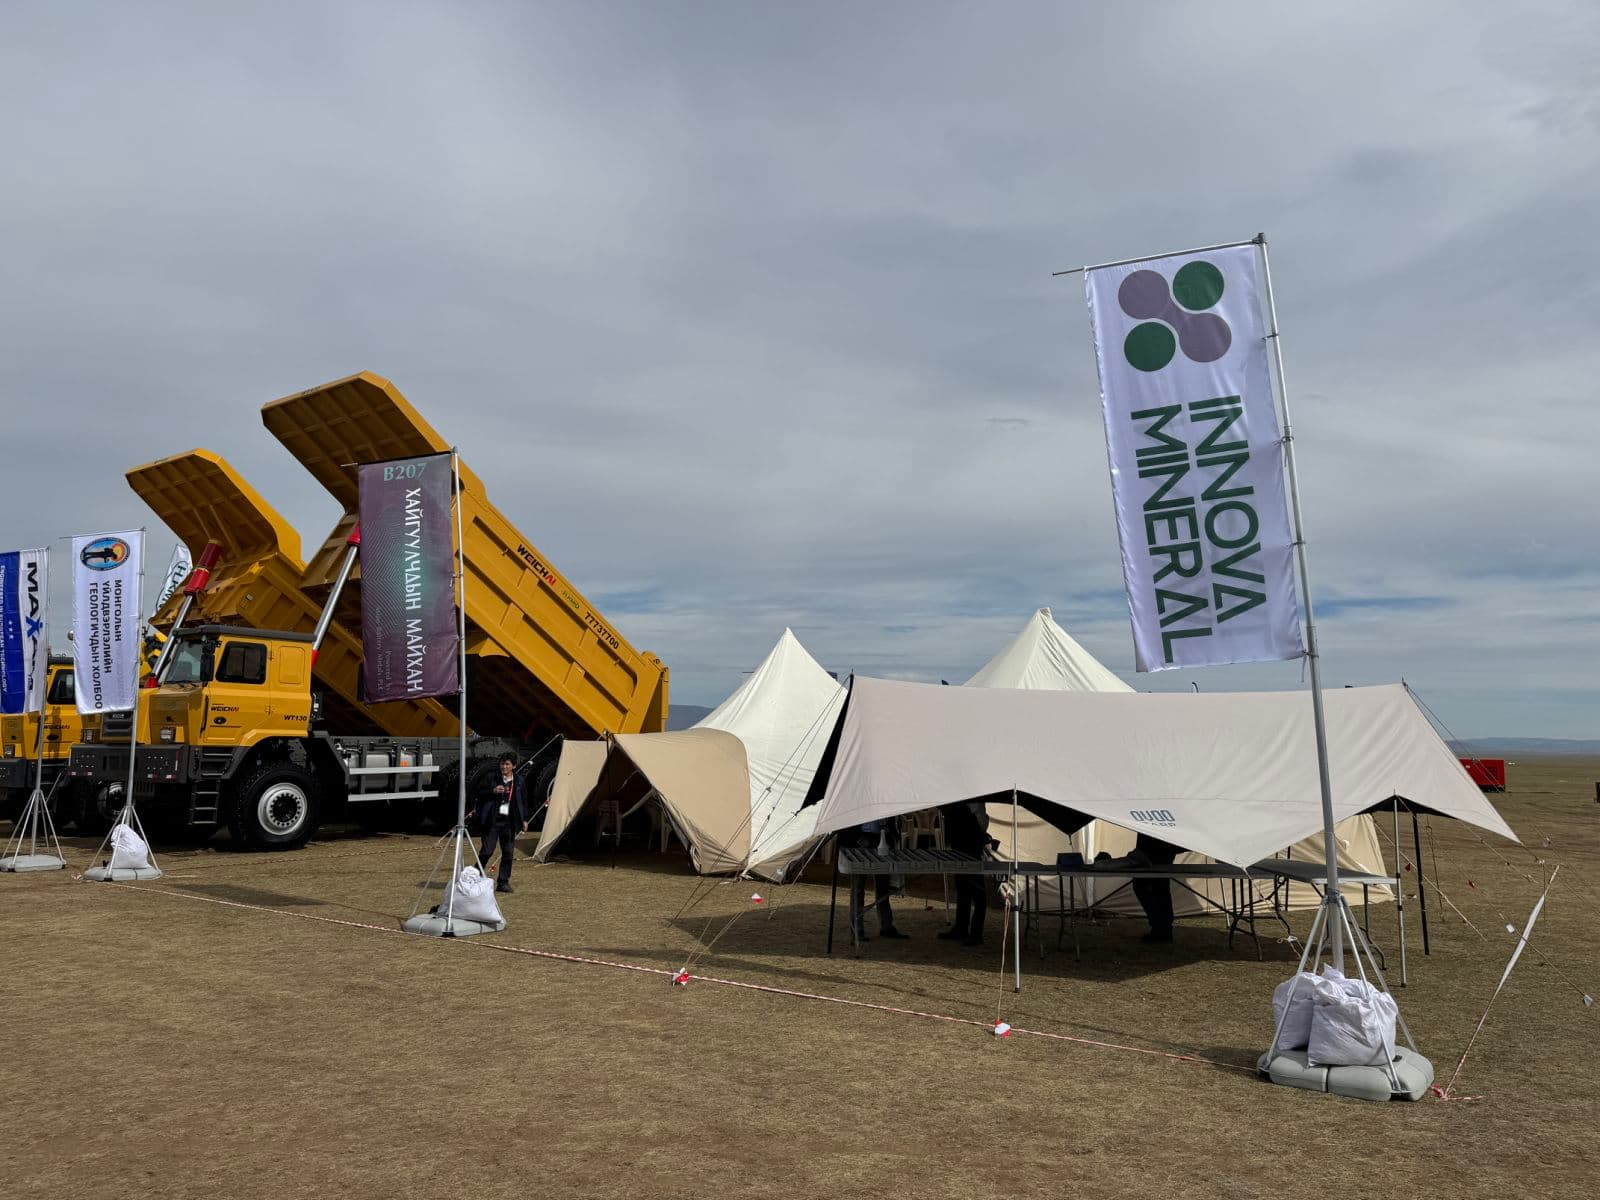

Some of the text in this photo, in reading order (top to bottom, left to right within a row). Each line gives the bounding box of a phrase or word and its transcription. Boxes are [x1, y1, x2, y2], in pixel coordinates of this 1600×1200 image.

[383, 463, 427, 481] B207
[1188, 394, 1267, 625] INNOVA
[517, 544, 557, 586] WEICHAI
[1130, 403, 1213, 664] MINERAL
[114, 579, 122, 642] МОНГОЛЫН
[404, 487, 427, 692] ХАЙГУУЛЧДЫН МАЙХАН
[584, 611, 620, 650] 77737700
[89, 582, 103, 709] ГЕОЛОГИЧДЫН ХОЛБОО
